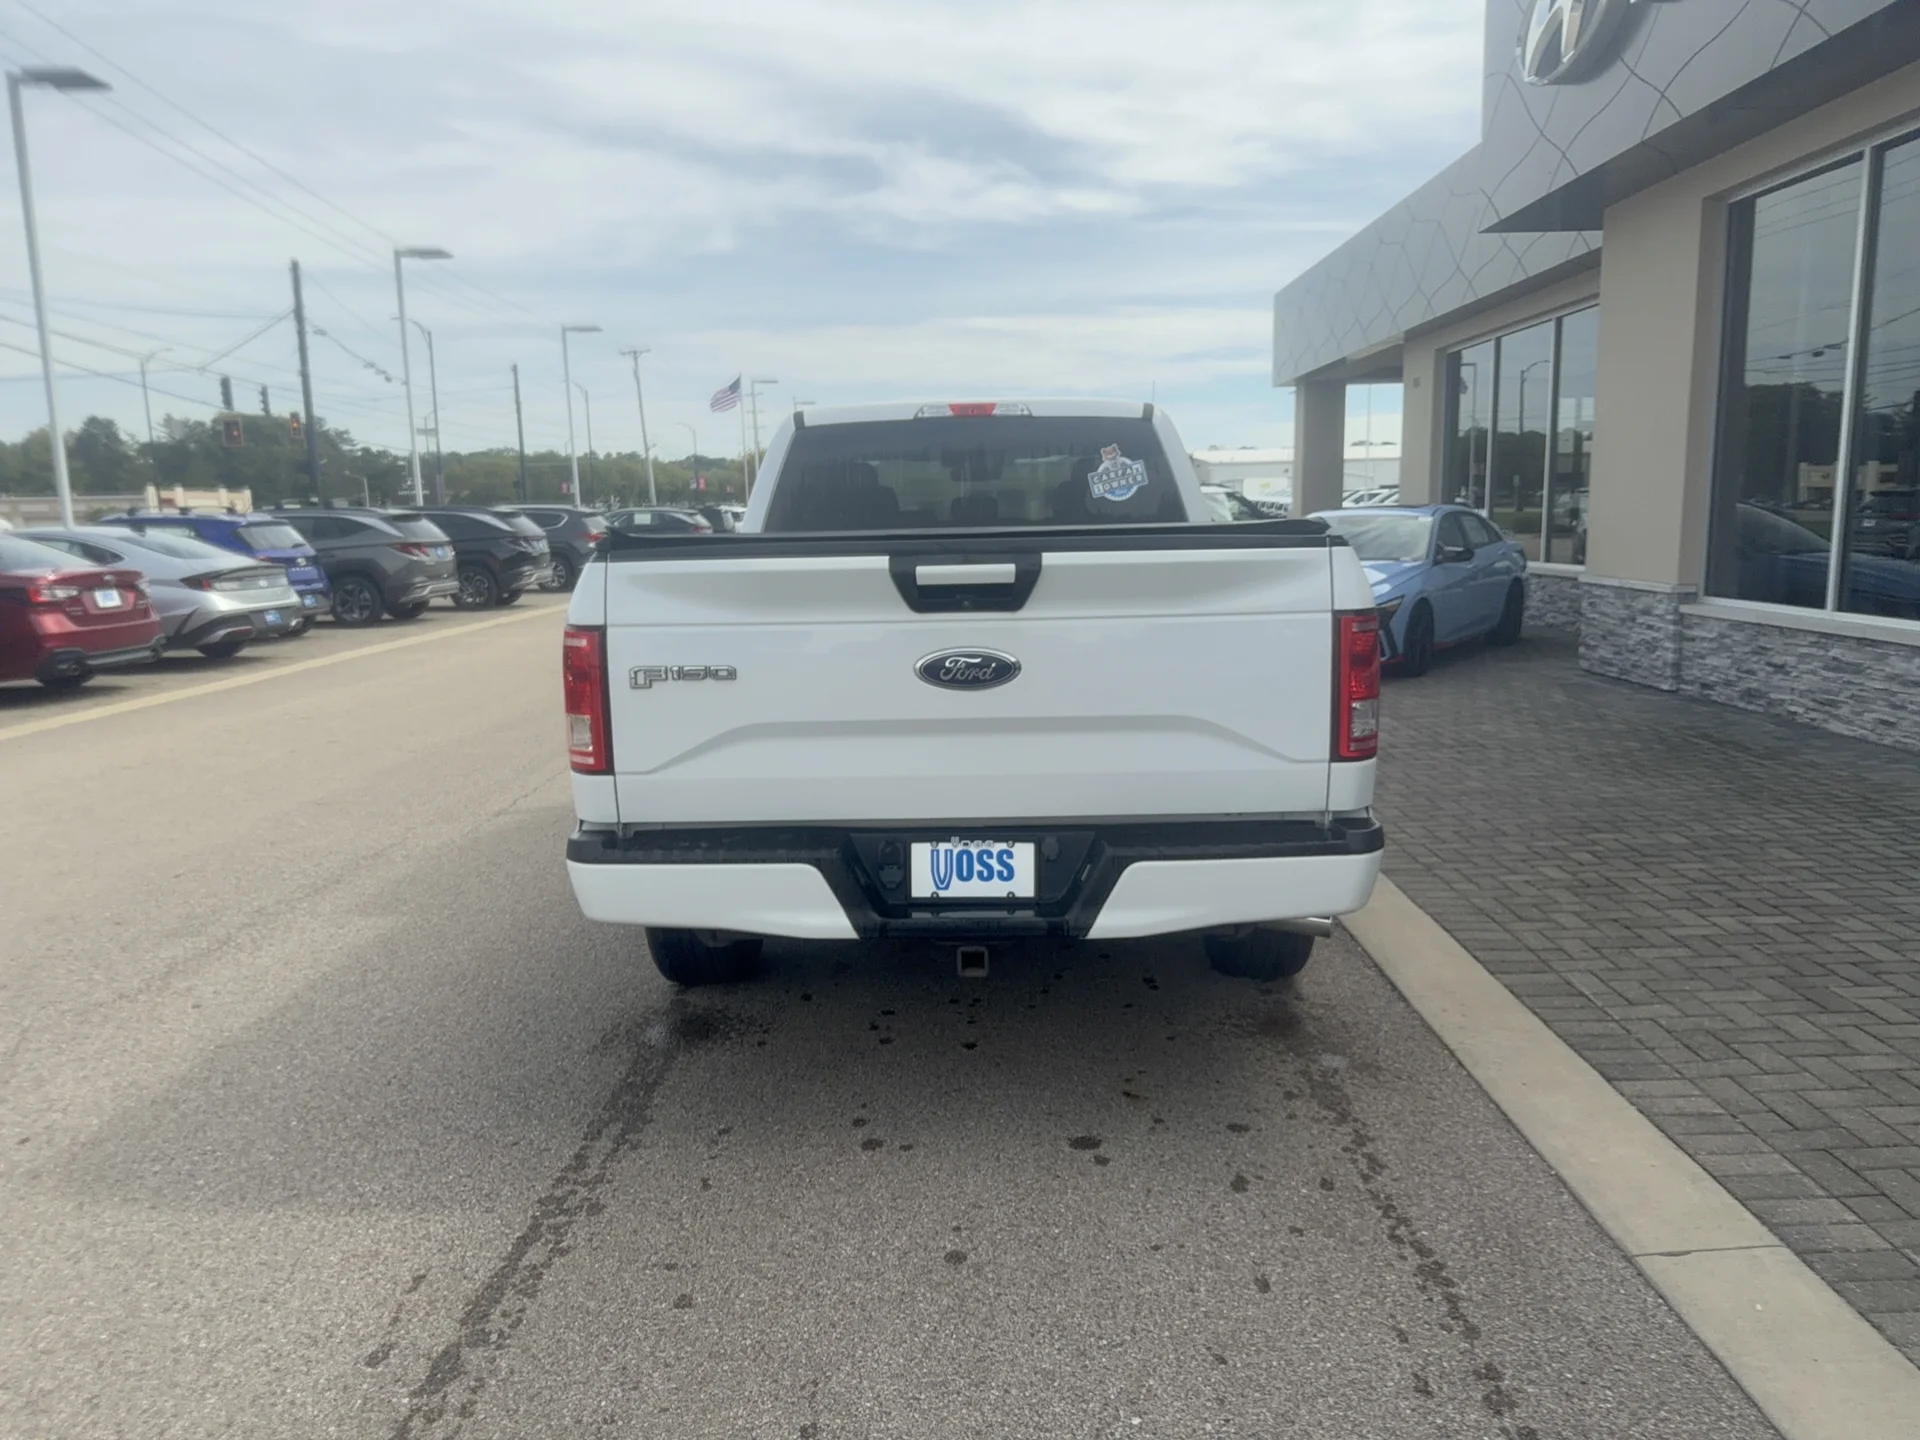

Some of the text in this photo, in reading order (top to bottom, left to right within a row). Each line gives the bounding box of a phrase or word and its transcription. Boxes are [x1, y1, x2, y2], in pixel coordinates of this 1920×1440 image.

[1093, 464, 1143, 484] CARFAX
[1103, 474, 1143, 491] OWNER
[940, 656, 997, 681] Ford
[930, 848, 1015, 891] VOSS
